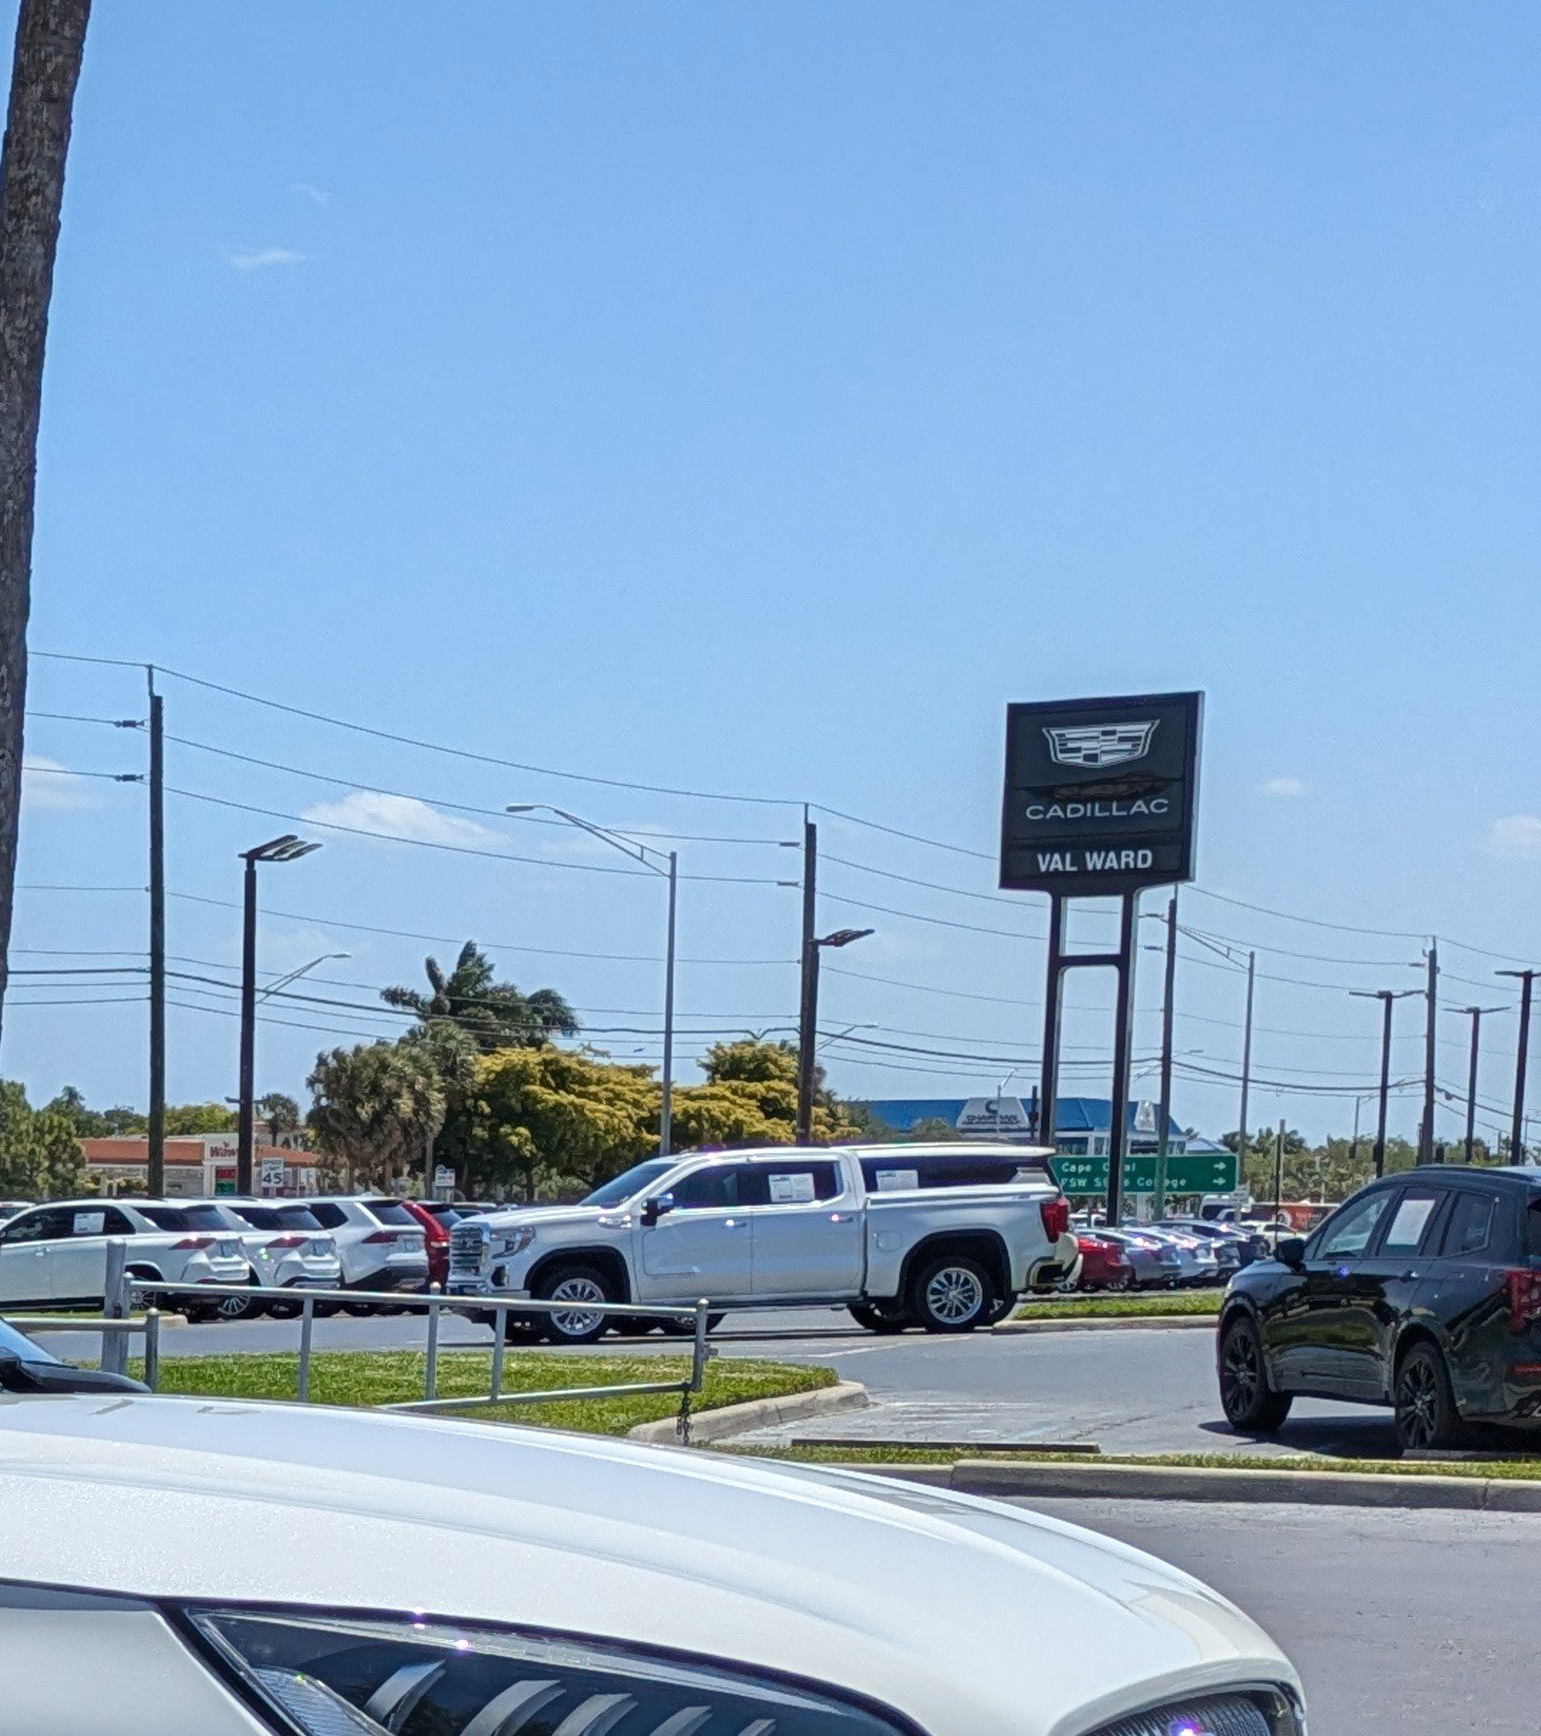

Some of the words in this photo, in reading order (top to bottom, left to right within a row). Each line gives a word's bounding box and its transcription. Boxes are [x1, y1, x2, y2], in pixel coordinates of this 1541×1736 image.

[1025, 798, 1169, 820] CADILLAC
[1037, 851, 1079, 872] VAL
[1085, 849, 1153, 870] WARD
[1061, 1161, 1092, 1175] Cape
[1102, 1161, 1136, 1173] Cal
[262, 1172, 283, 1184] 45
[1136, 1176, 1187, 1189] Colege
